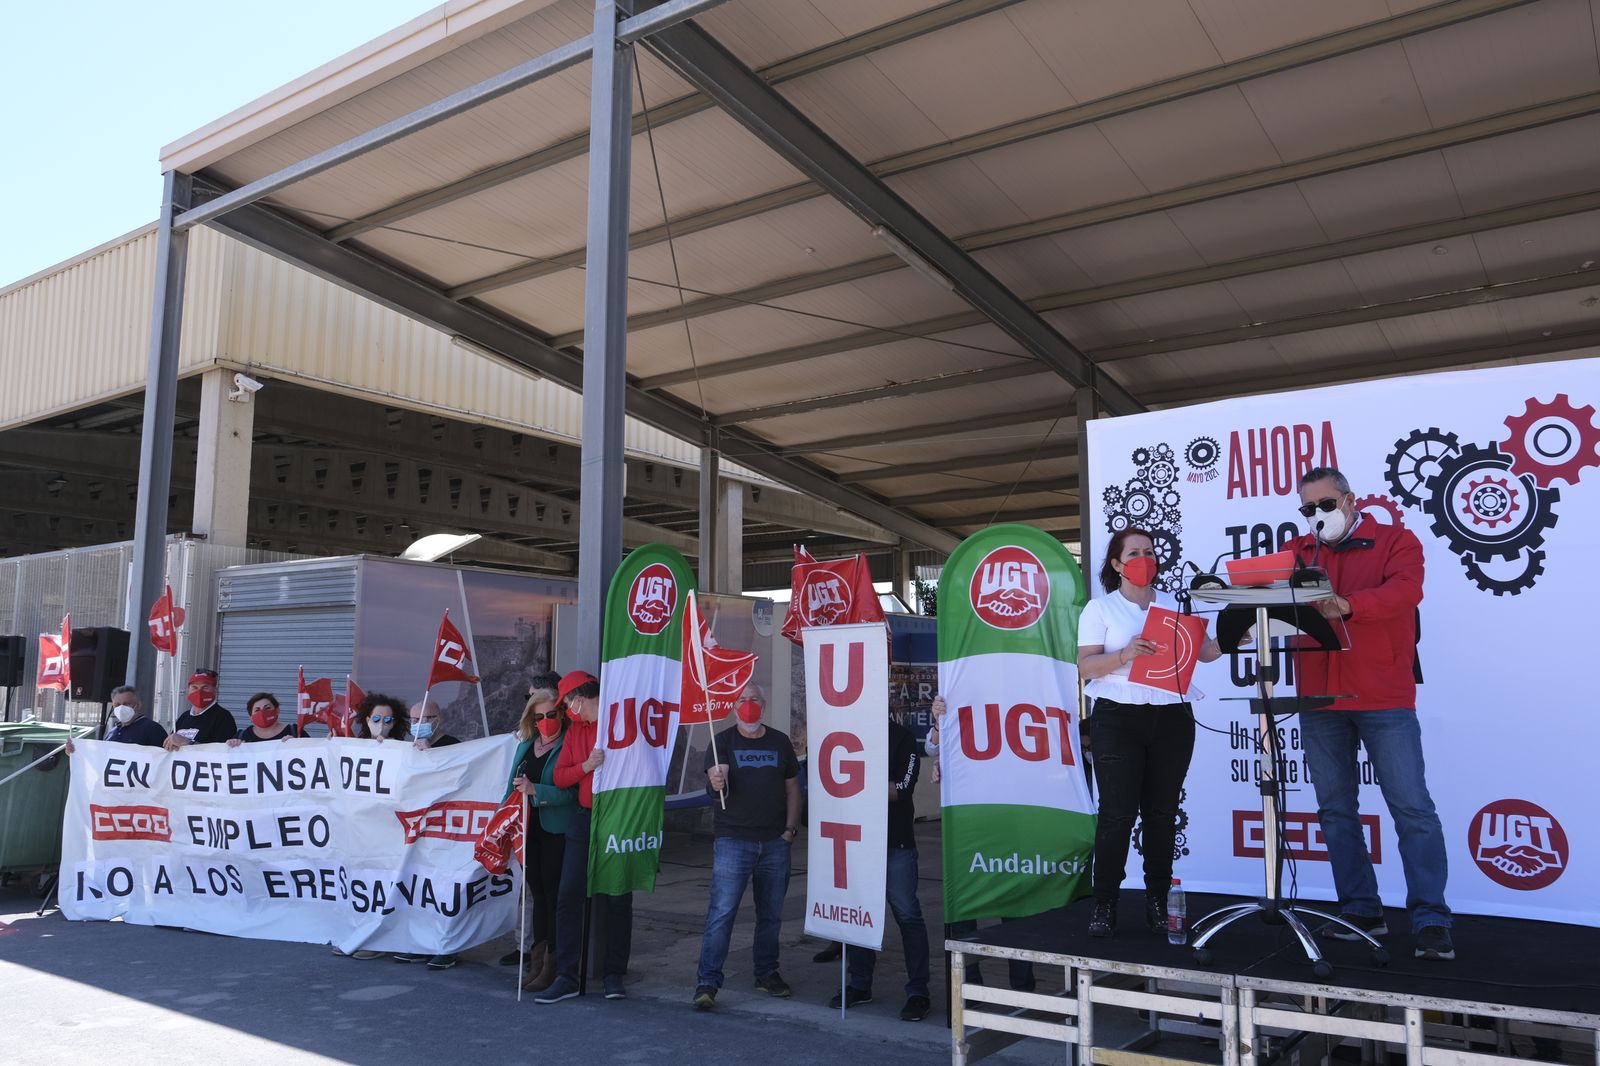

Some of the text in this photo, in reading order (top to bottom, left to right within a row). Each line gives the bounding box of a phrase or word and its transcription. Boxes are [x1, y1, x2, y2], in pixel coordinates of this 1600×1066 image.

[1186, 468, 1220, 484] MAYO 2021
[1227, 421, 1338, 500] AHORA
[635, 576, 672, 604] UGT
[807, 578, 842, 610] UGT
[980, 562, 1039, 594] UGT
[606, 697, 680, 750] UGT
[957, 703, 1076, 767] UGT
[1230, 721, 1248, 750] Un
[104, 756, 391, 795] EN DEFENSA DEL
[1231, 759, 1249, 783] su
[94, 811, 169, 836] CCOO
[187, 814, 331, 850] EMPLEO
[1480, 813, 1553, 853] UGT
[154, 865, 174, 895] A
[186, 864, 243, 897] LOS
[263, 865, 348, 902] ERES
[812, 902, 874, 928] ALMERÍA
